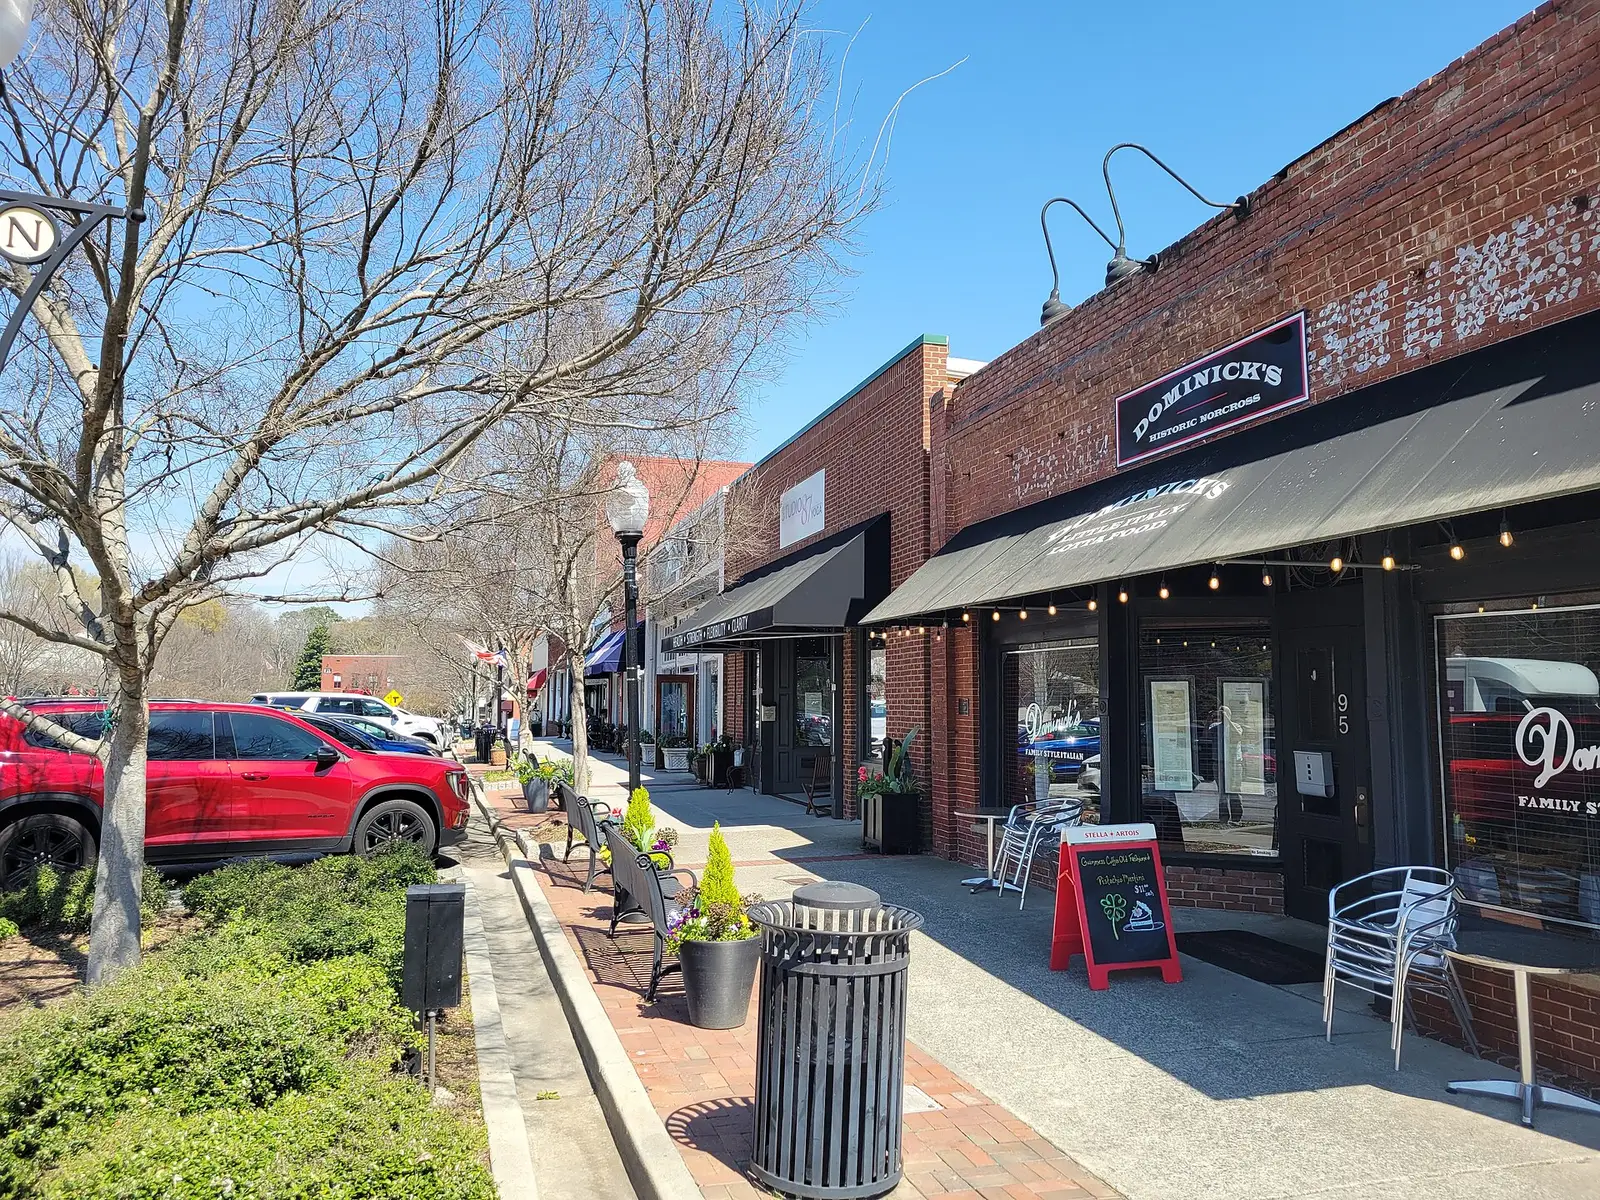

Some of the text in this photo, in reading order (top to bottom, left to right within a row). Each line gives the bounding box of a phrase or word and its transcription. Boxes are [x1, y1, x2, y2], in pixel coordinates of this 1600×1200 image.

[6, 216, 43, 251] N
[1132, 361, 1283, 443] DOMINICK'S
[1149, 393, 1261, 443] HISTORIC NORCROSS
[1058, 520, 1123, 543] LITTLE
[1047, 534, 1107, 555] LOTTA
[706, 622, 726, 639] FLEXIBILITY
[731, 615, 749, 632] CLARITY
[1025, 748, 1084, 760] FAMILY STYLE ITALIAN
[1518, 796, 1581, 812] FAMILY
